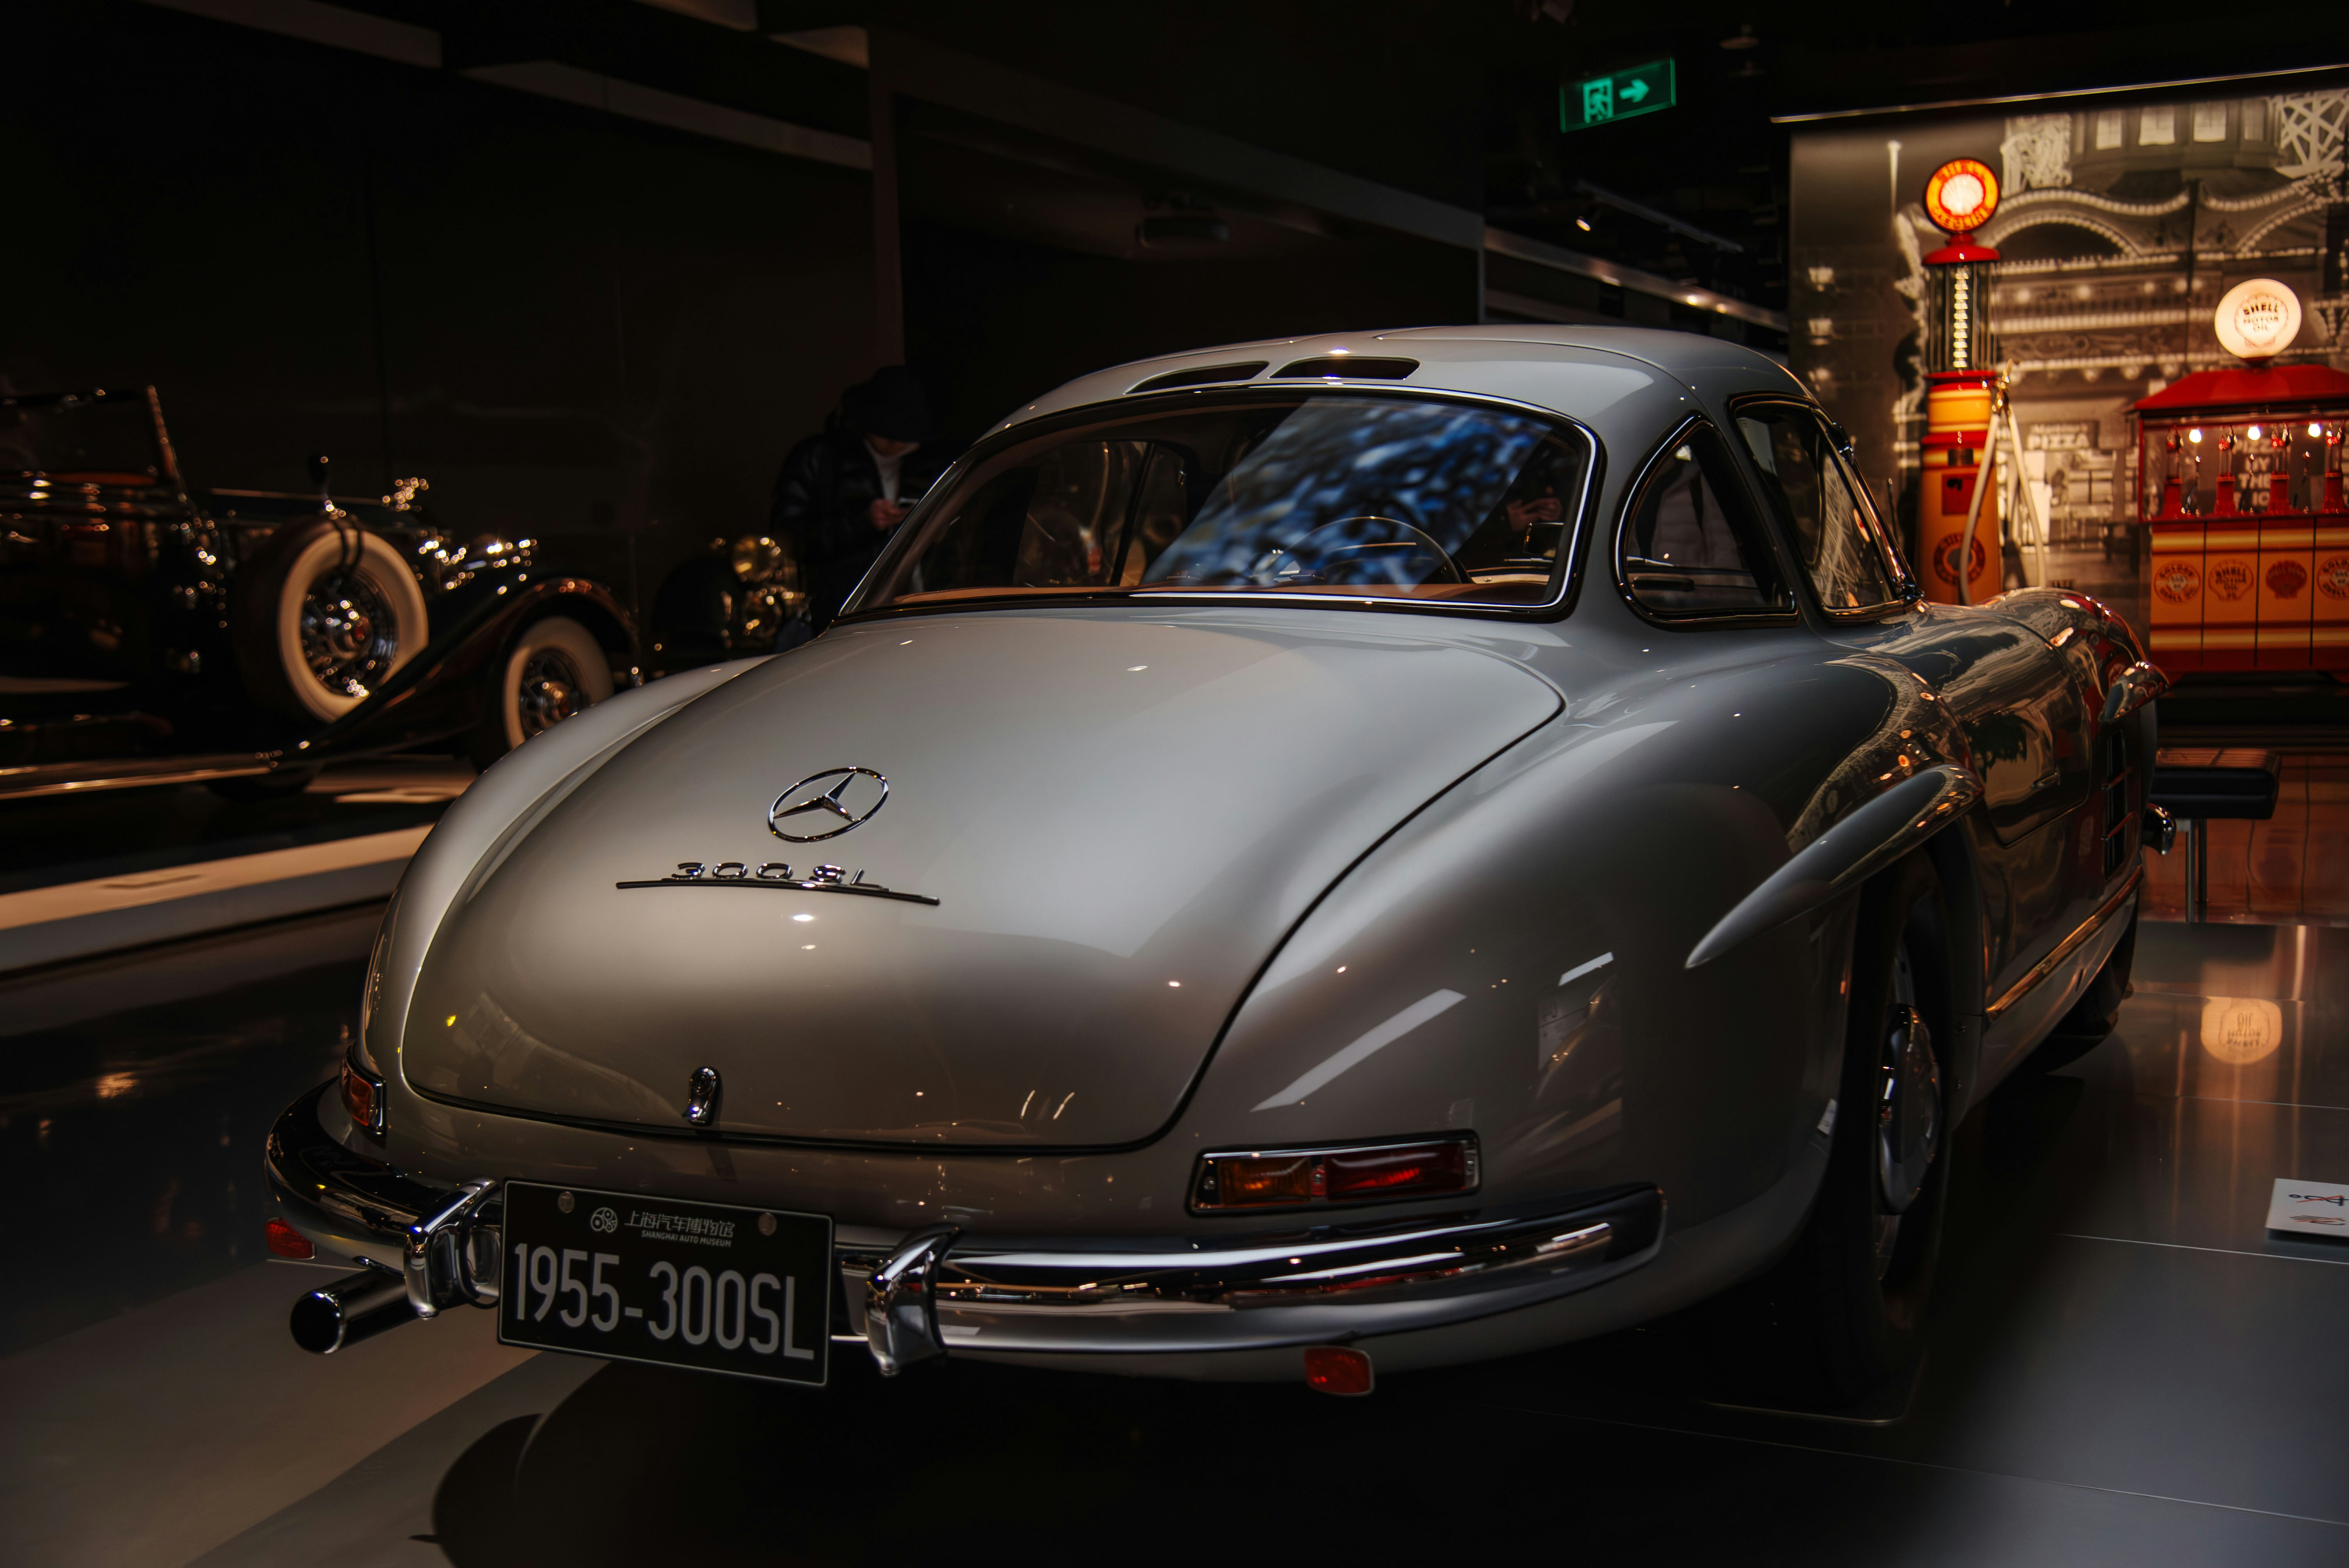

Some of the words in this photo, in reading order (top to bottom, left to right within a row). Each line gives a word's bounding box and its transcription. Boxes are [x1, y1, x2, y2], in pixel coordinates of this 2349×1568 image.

[2242, 301, 2279, 315] SHELL
[2243, 315, 2279, 325] MOTOR
[2253, 323, 2269, 333] OIL
[2028, 433, 2089, 449] PIZZA
[671, 862, 794, 879] 300
[809, 864, 888, 889] SL
[624, 1210, 736, 1238] 上海汽车博物馆
[641, 1230, 678, 1242] SHANGHAI
[679, 1234, 699, 1244] AUTO
[700, 1237, 732, 1248] MUSEUM
[514, 1243, 814, 1360] 1955-300SL
